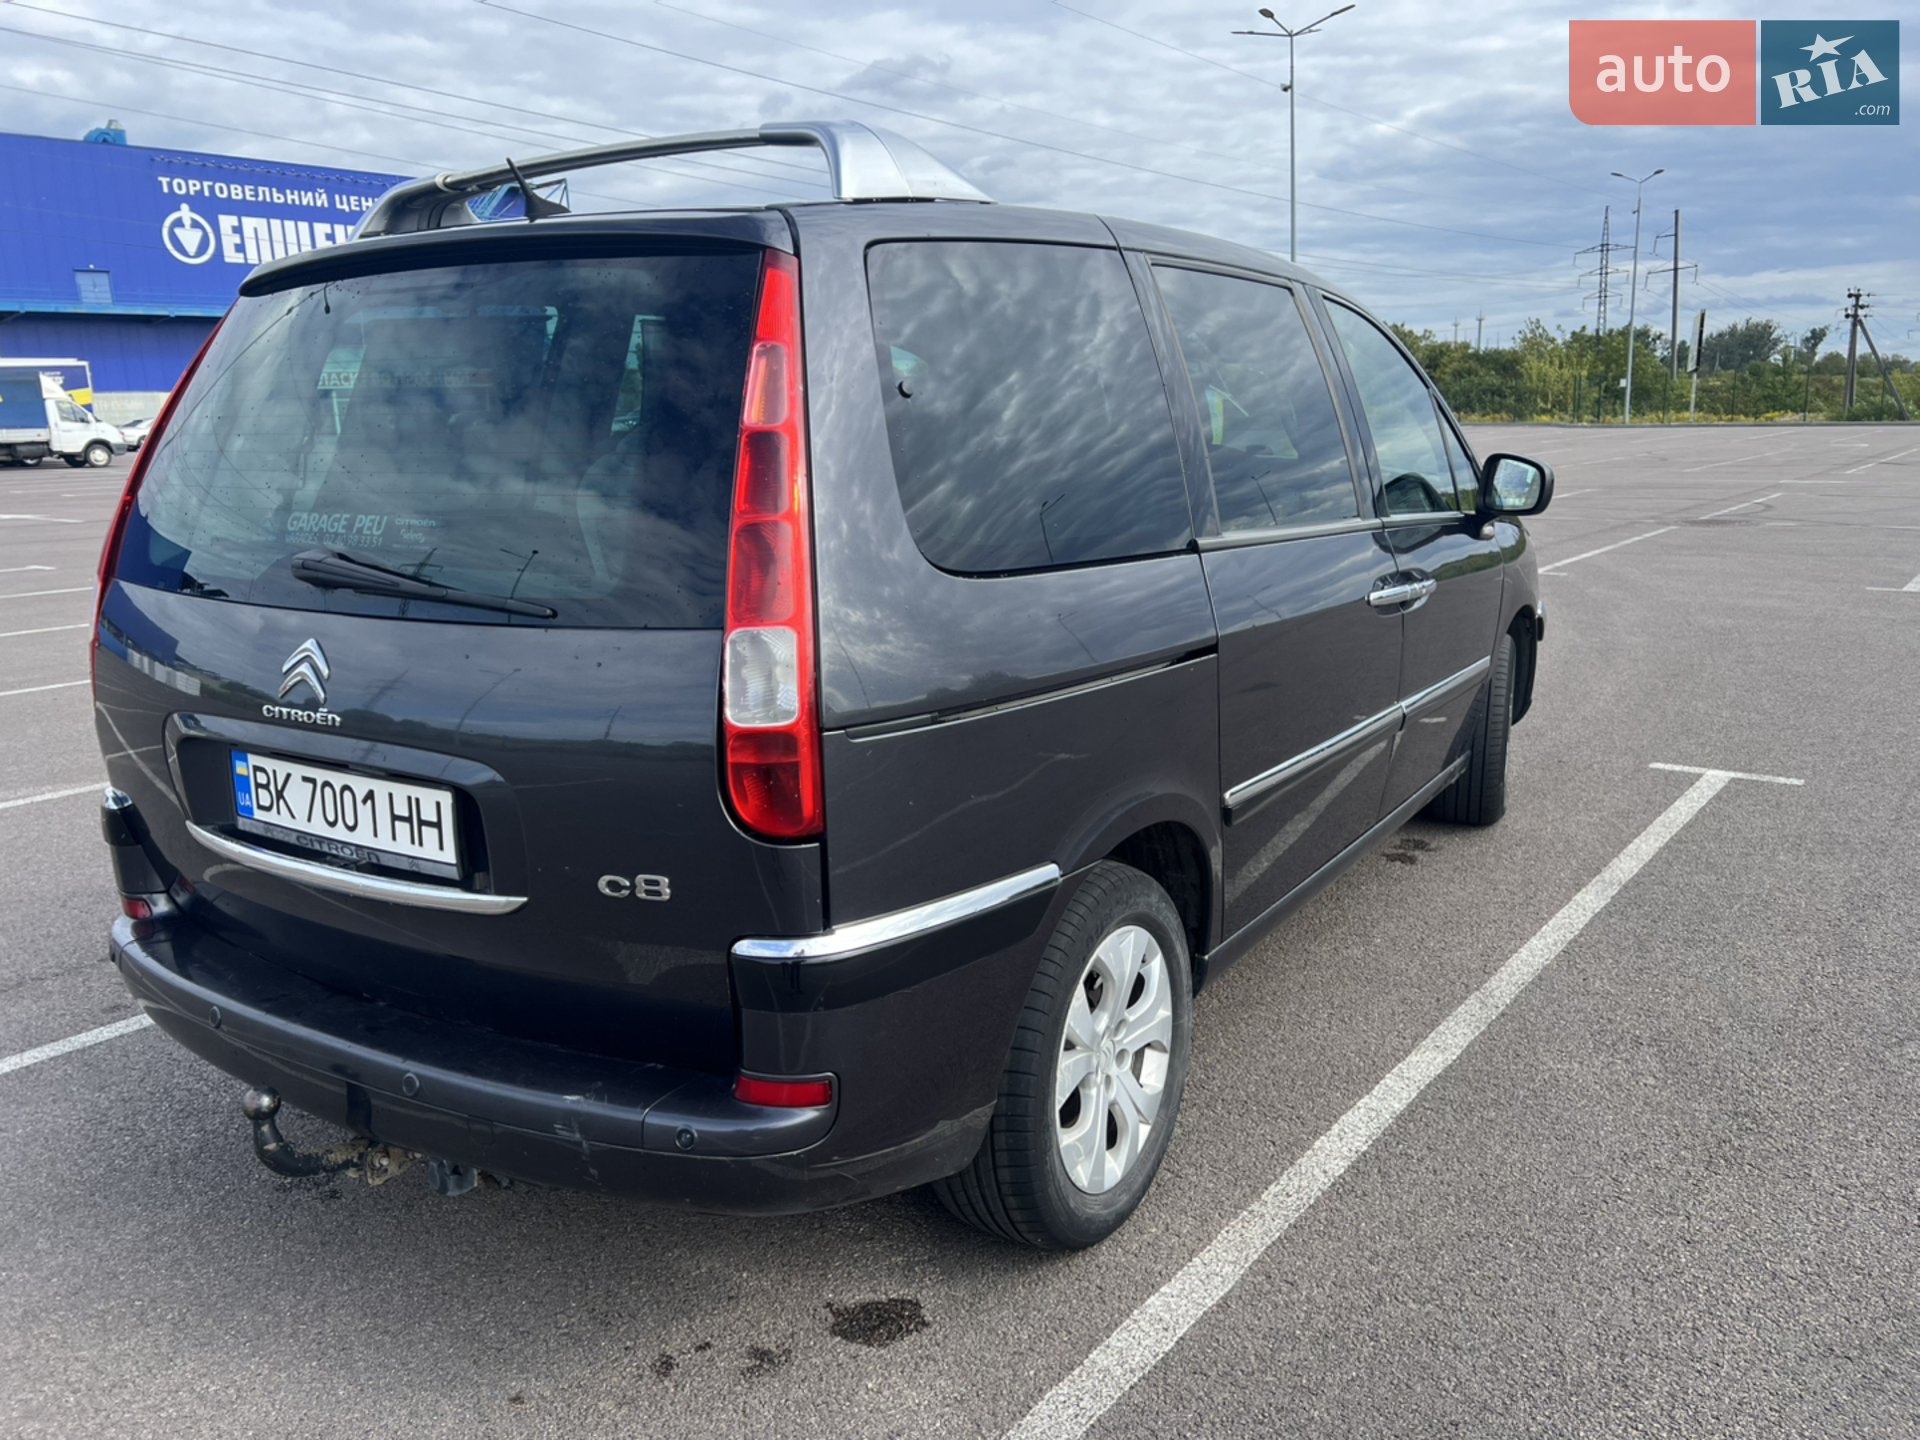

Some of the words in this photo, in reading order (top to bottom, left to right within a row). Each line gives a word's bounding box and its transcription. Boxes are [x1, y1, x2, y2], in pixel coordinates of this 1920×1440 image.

[157, 176, 329, 209] ТОРГОВЕЛЬНИЙ
[334, 193, 379, 213] ЦЕН
[287, 512, 350, 533] GARAGE
[352, 514, 387, 535] PEU
[237, 790, 252, 807] UA
[252, 764, 296, 820] BK
[301, 775, 378, 839] 7001
[388, 792, 444, 852] HH
[597, 873, 671, 901] C8
